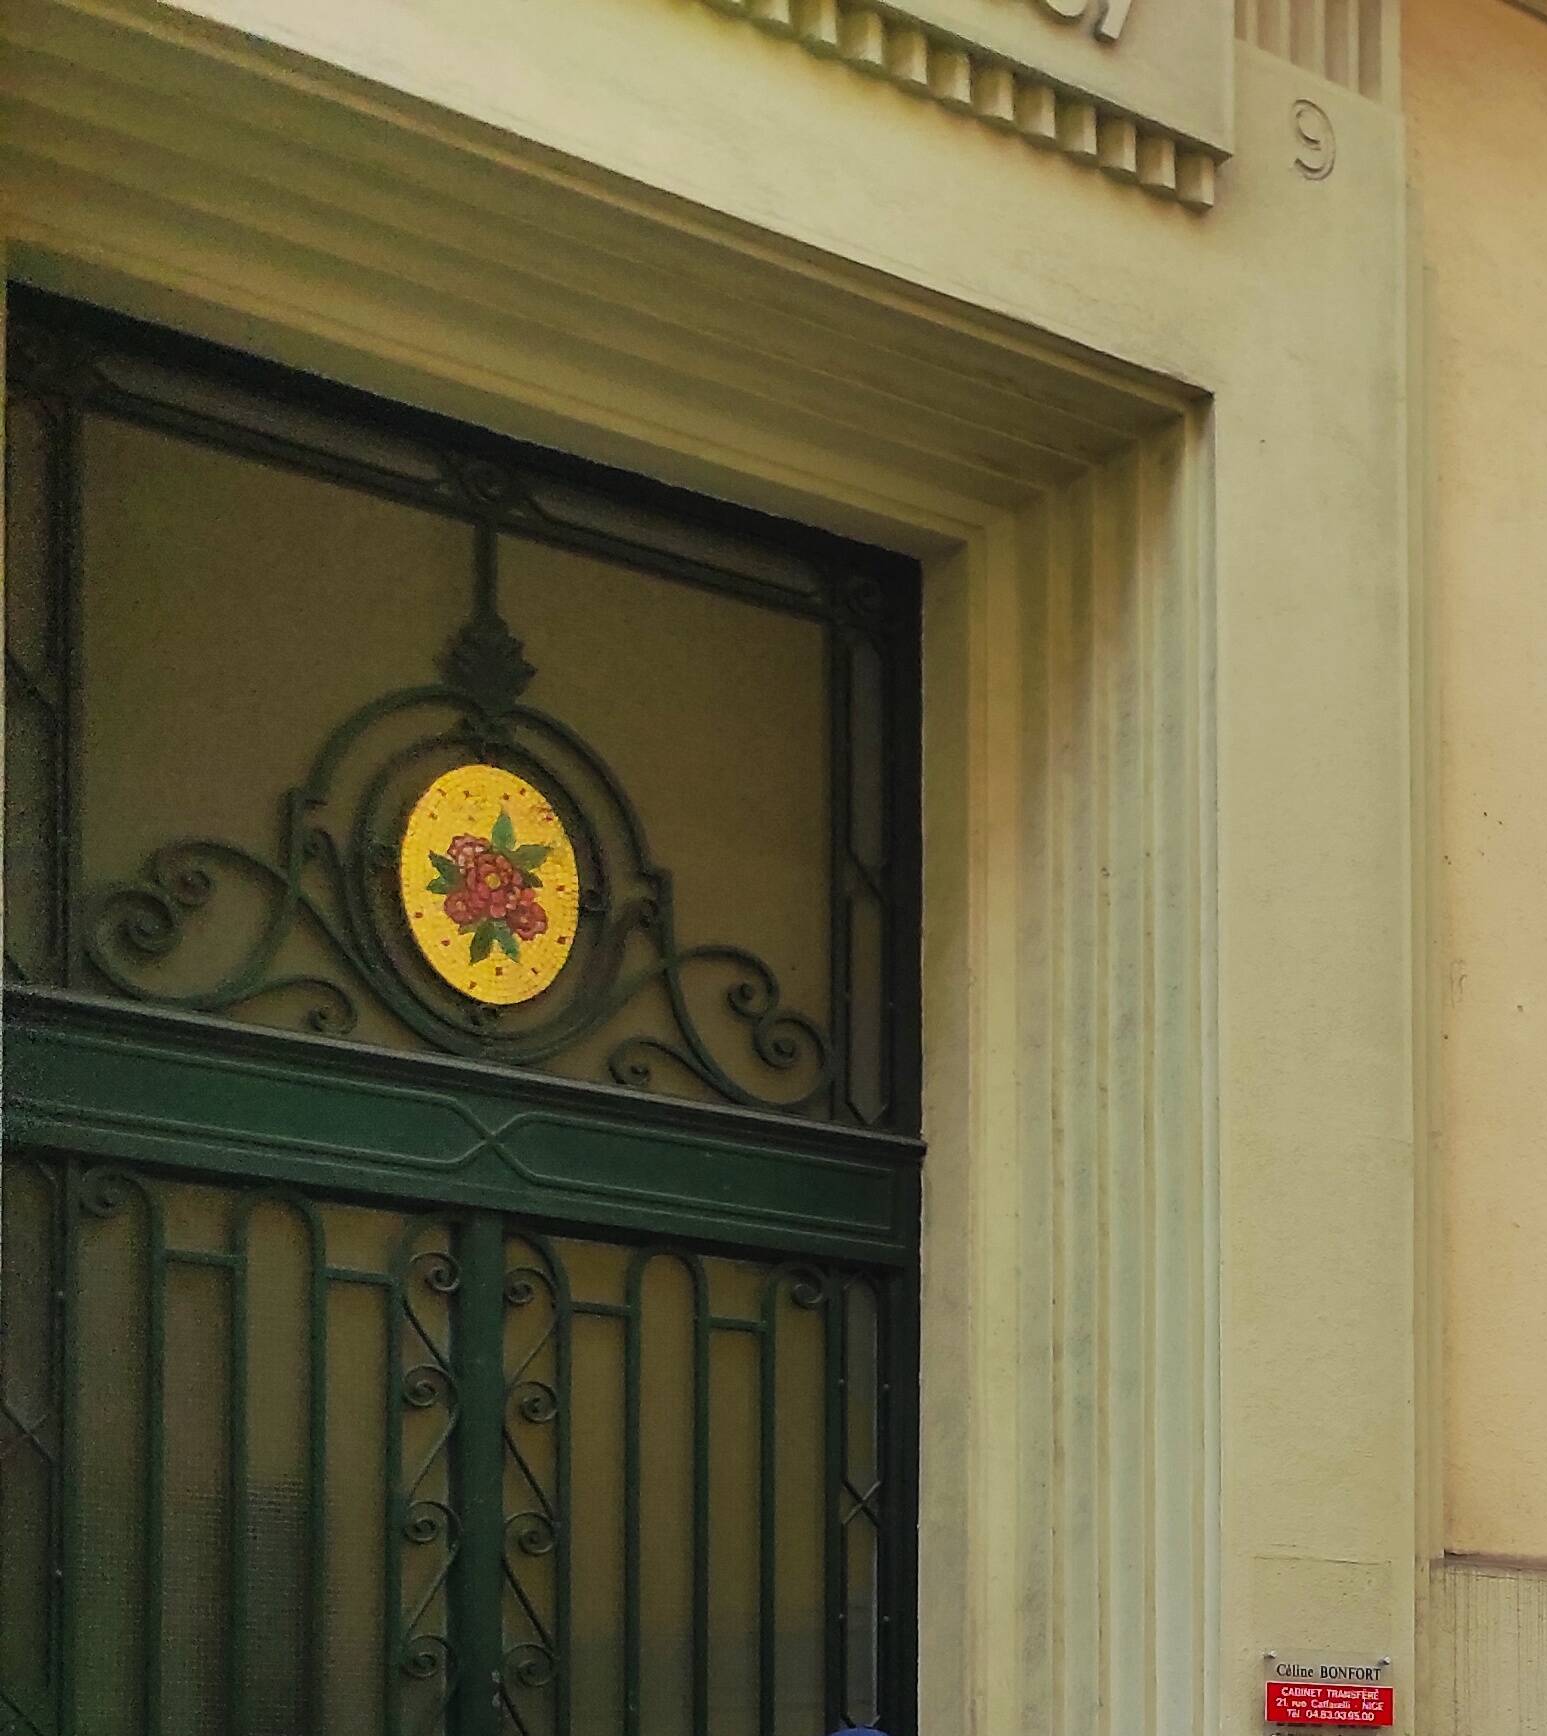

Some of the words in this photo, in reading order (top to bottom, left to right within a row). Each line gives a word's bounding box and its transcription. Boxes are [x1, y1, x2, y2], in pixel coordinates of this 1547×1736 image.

[1292, 98, 1337, 181] 9
[1276, 1663, 1314, 1678] Céline
[1320, 1665, 1382, 1680] BONFORT
[1281, 1686, 1322, 1698] CABINET
